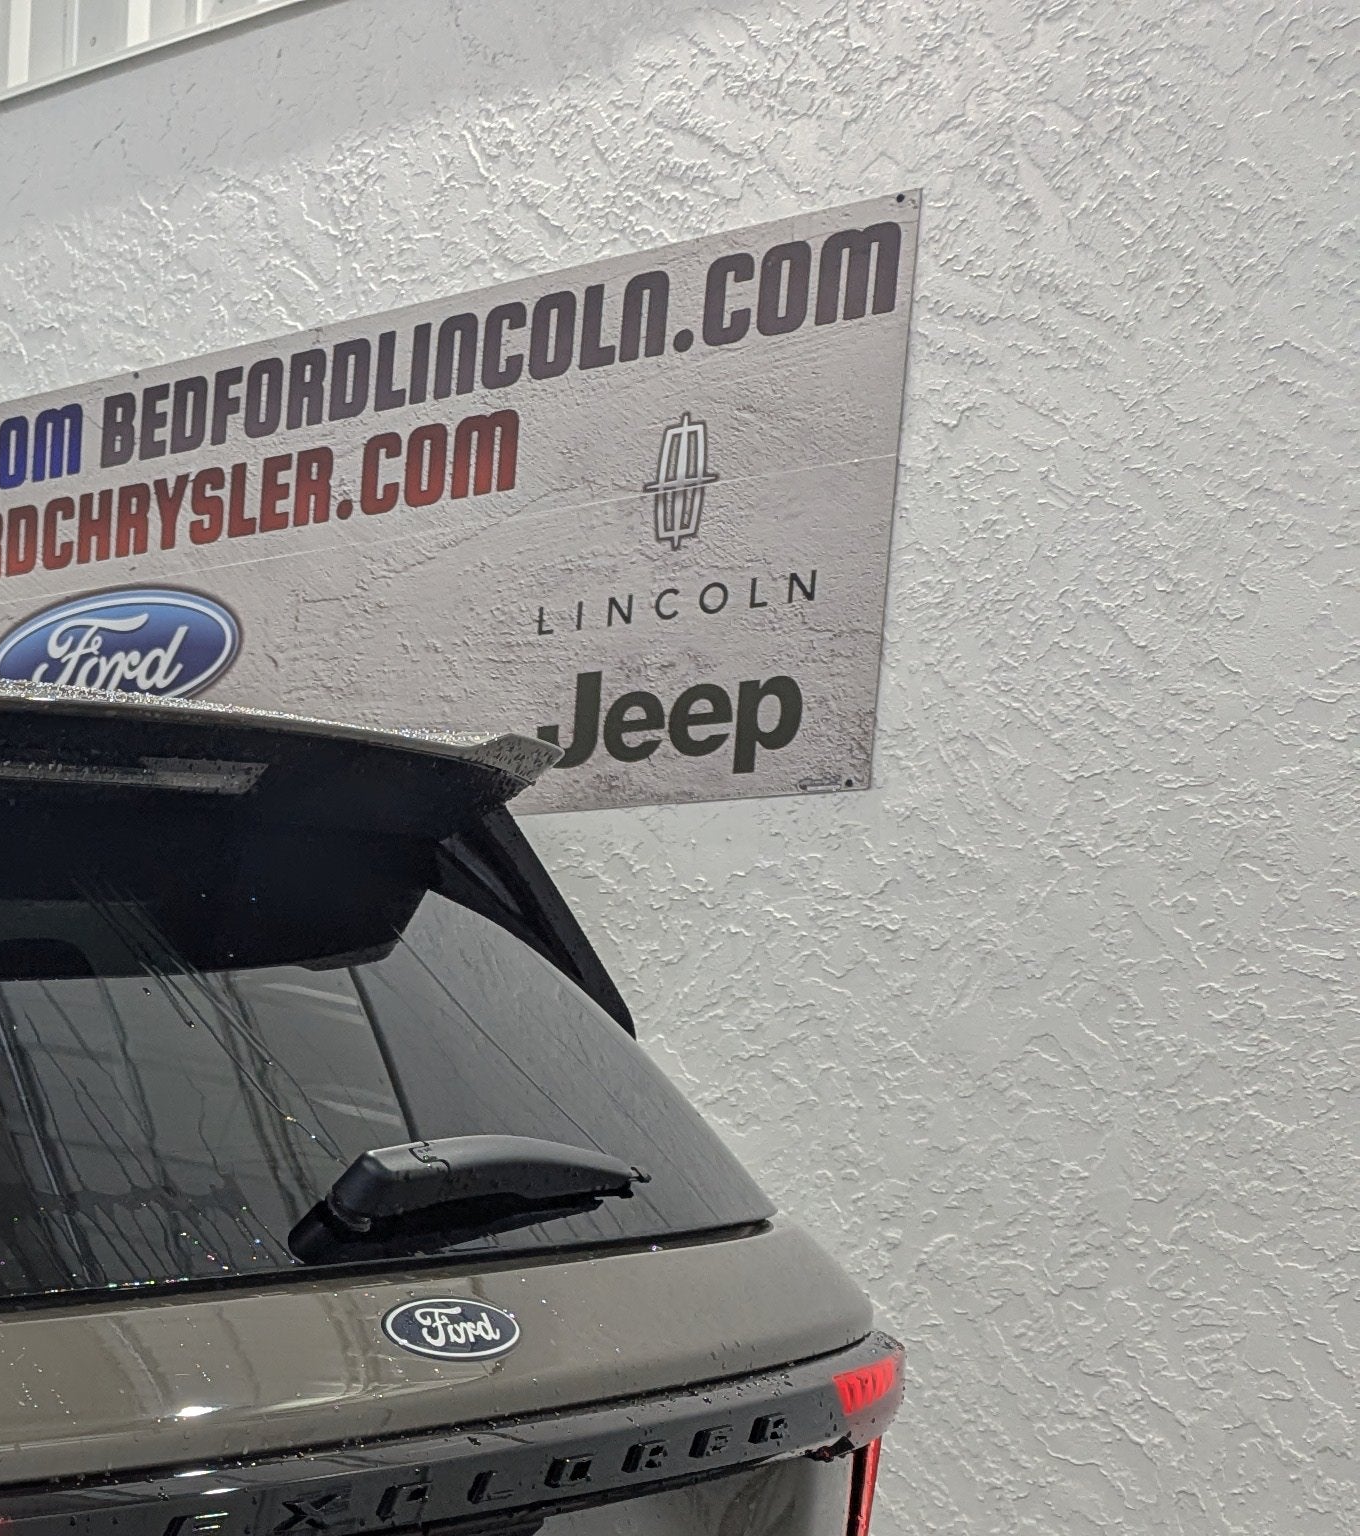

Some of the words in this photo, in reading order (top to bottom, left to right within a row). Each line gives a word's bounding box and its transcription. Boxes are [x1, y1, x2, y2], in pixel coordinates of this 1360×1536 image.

[100, 221, 902, 469] BEDFORDLINCOLN.COM
[536, 569, 818, 636] LINCOLN
[32, 612, 190, 692] Ford
[536, 670, 803, 775] Jeep
[414, 1306, 501, 1347] Ford
